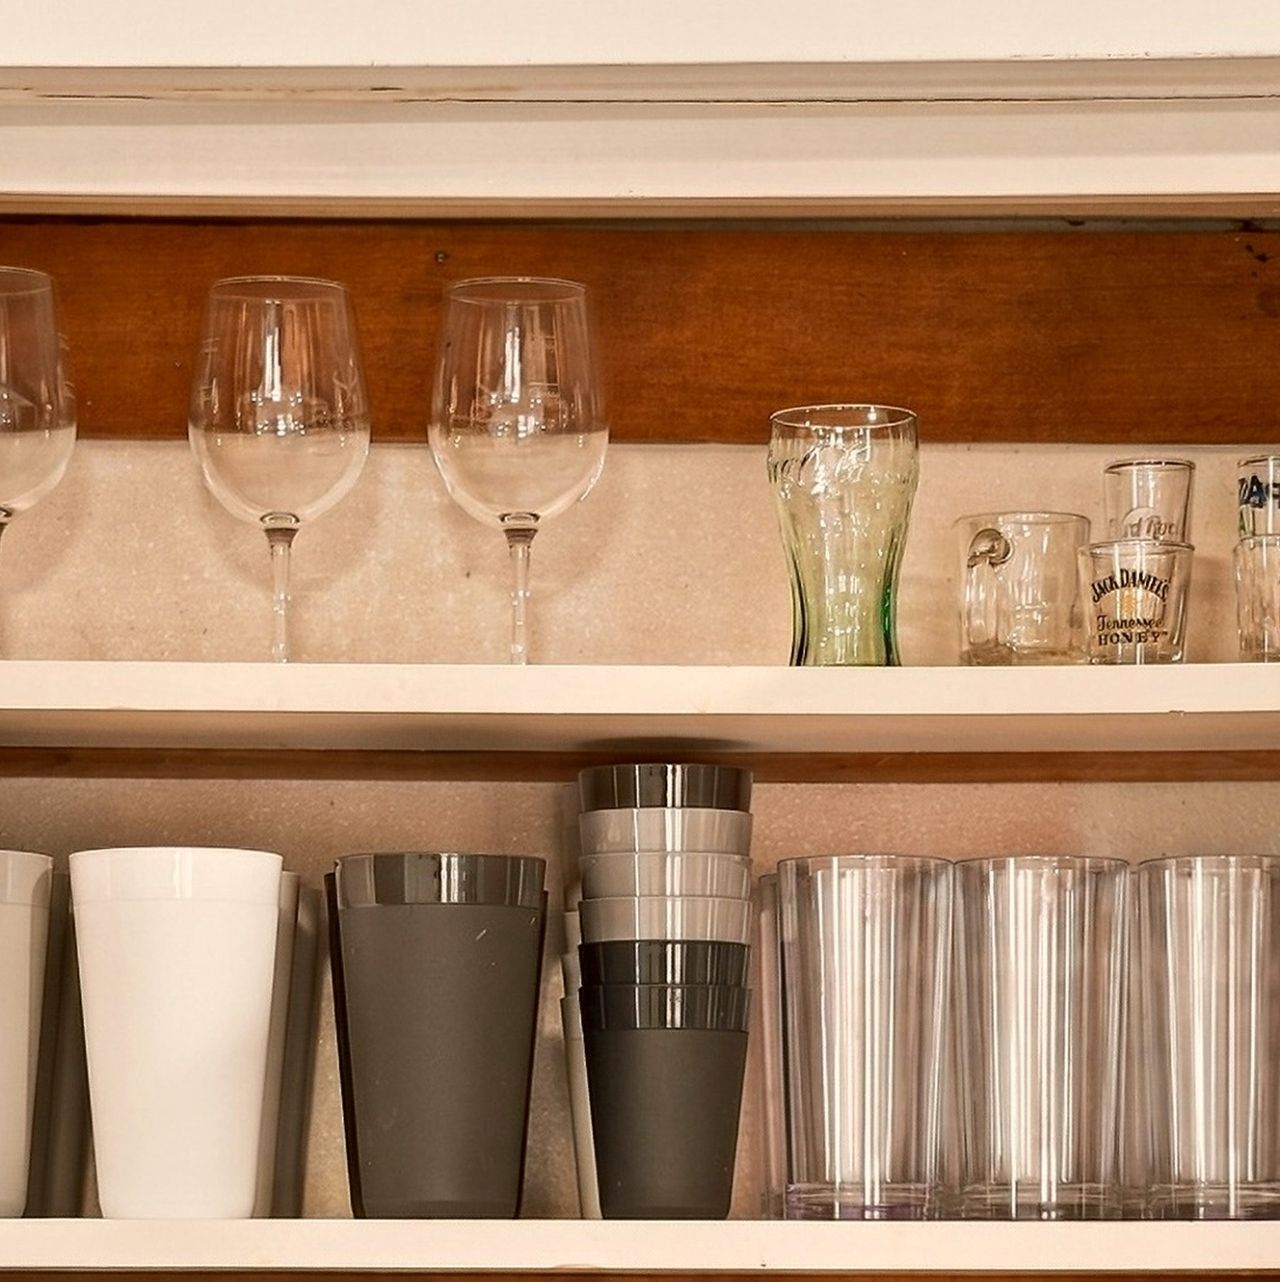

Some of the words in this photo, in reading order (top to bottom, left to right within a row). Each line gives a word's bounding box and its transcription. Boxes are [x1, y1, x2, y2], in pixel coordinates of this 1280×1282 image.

[1091, 575, 1119, 603] JACK
[1120, 568, 1170, 602] DANIEL'S
[1096, 615, 1164, 631] Tennessee
[1098, 632, 1161, 646] HONEY
